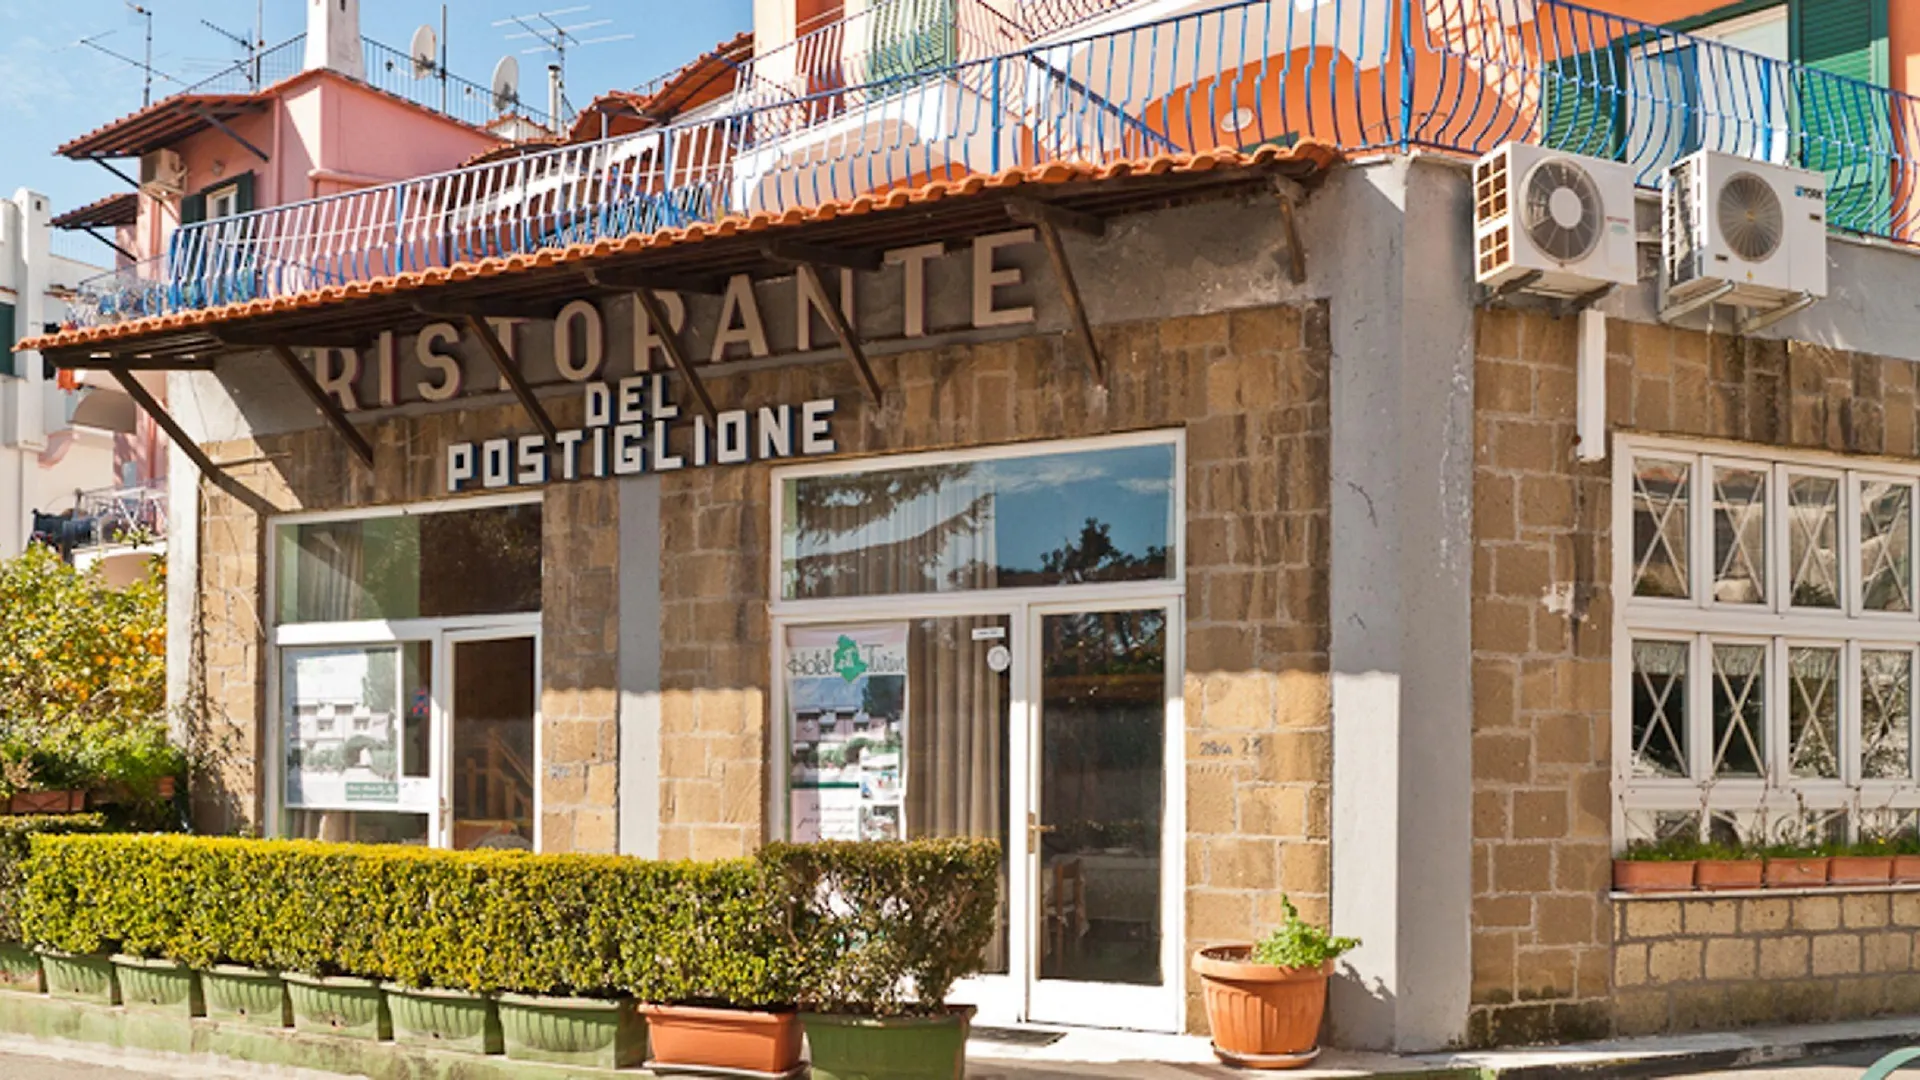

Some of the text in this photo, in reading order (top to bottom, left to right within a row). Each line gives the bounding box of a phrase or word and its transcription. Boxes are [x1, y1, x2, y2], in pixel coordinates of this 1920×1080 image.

[315, 228, 1037, 413] RISTORANTE
[448, 398, 836, 492] POSTIGLIONE
[585, 374, 678, 428] DEL
